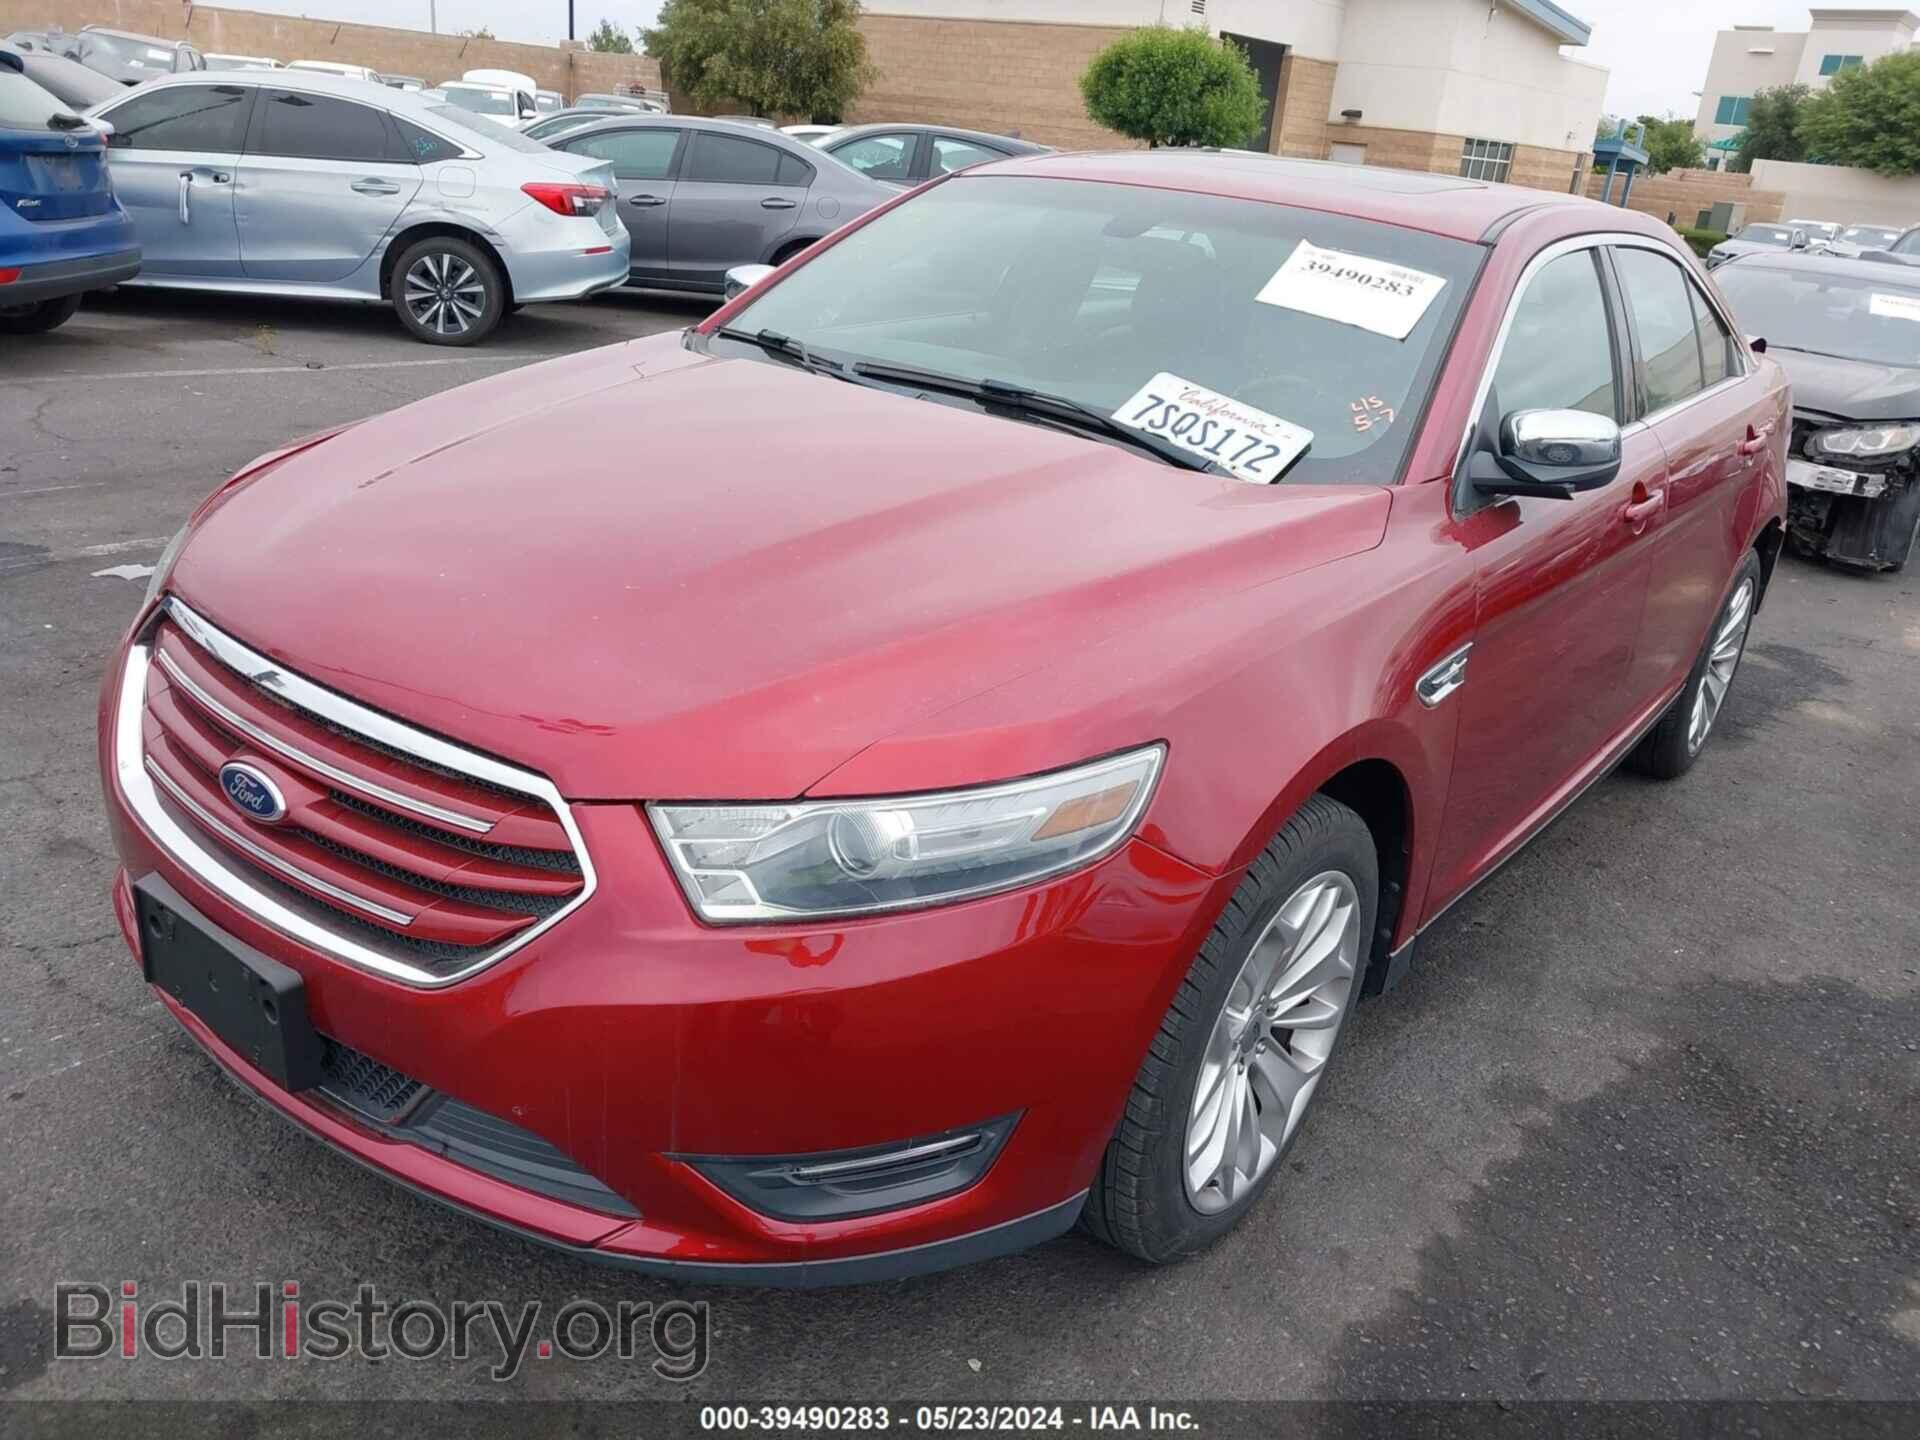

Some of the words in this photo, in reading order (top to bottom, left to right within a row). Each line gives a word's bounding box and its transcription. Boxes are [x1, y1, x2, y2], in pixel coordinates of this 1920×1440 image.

[1300, 259, 1415, 297] 39490283
[1131, 394, 1281, 473] 7SQS172
[1178, 389, 1273, 436] California
[229, 773, 265, 811] Ford
